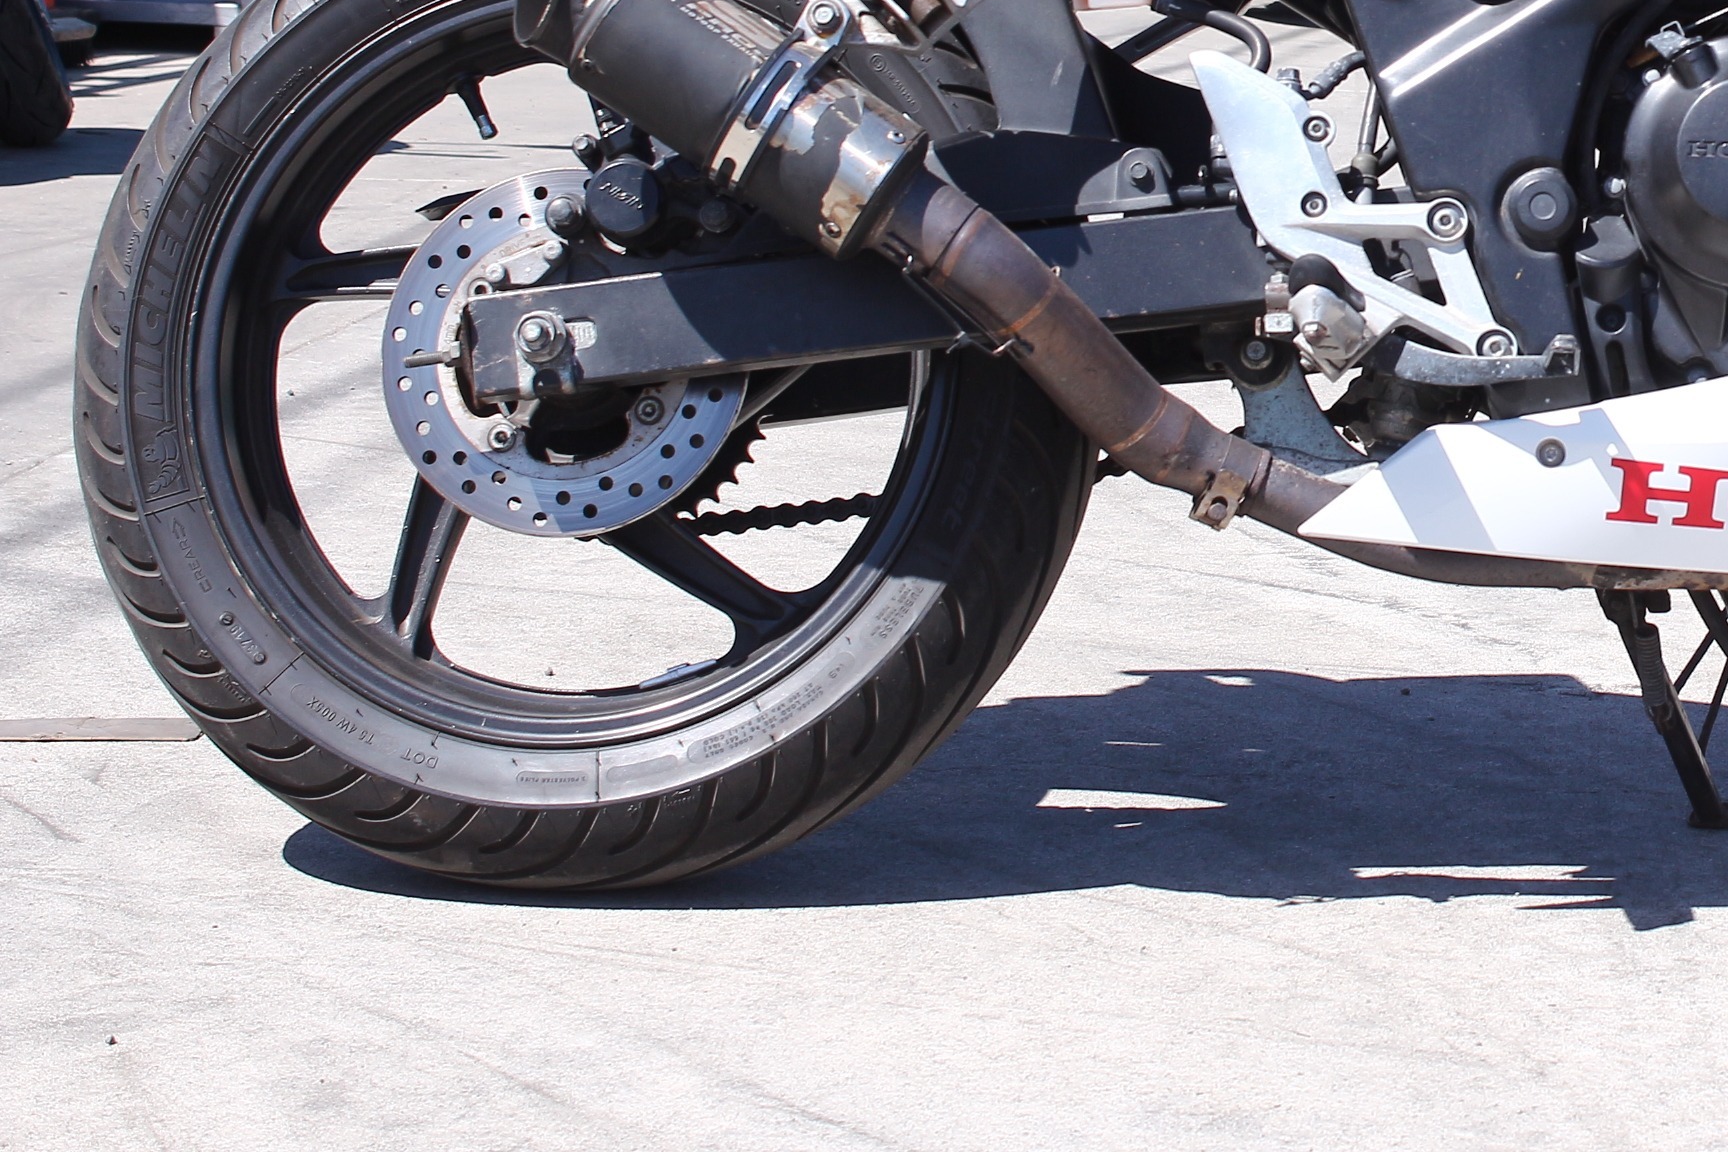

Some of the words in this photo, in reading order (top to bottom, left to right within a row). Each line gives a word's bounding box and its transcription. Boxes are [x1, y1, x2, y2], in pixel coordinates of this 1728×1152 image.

[134, 144, 227, 425] MICHELIN
[177, 537, 206, 582] REAR
[879, 586, 925, 639] TUBELESS
[399, 745, 439, 770] DOT
